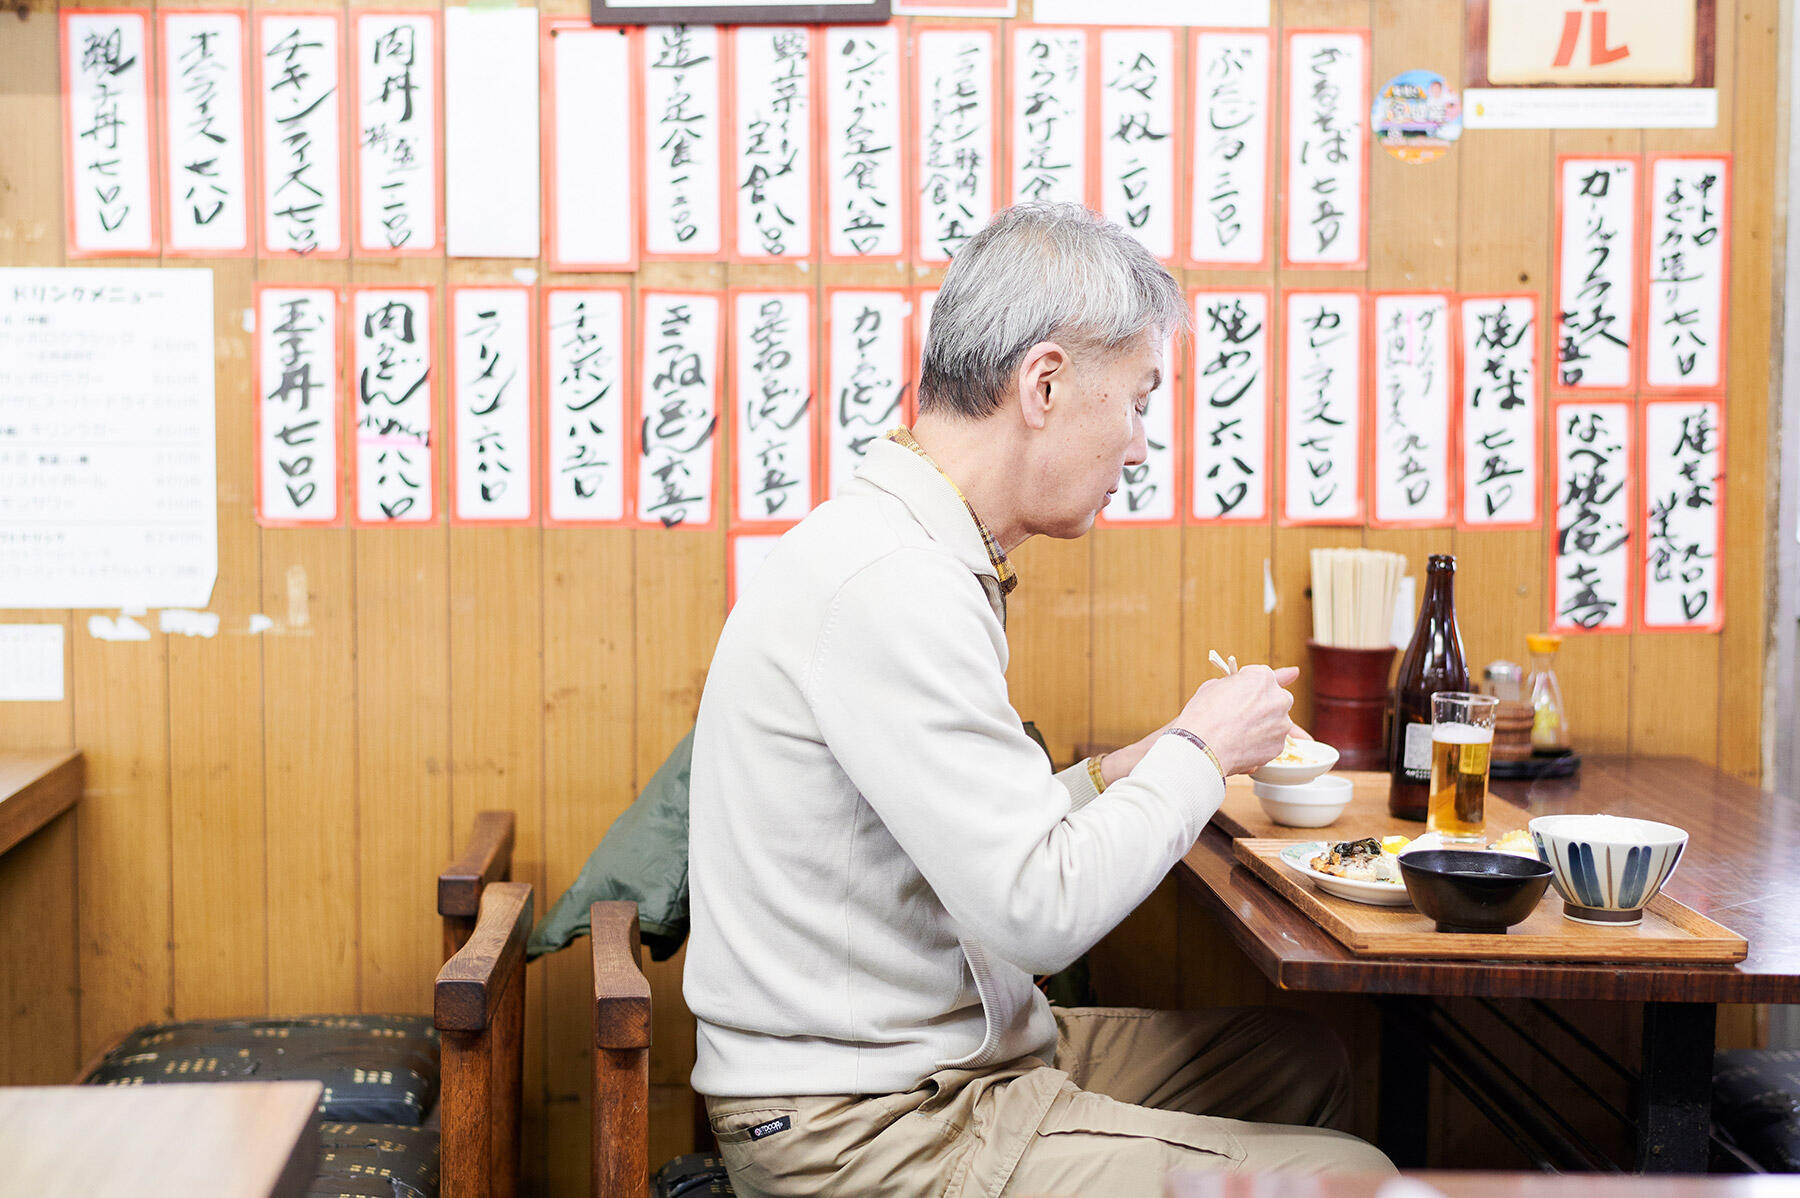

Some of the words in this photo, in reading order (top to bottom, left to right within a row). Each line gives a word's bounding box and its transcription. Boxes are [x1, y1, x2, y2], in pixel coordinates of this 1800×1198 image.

[1553, 0, 1630, 67] ル
[13, 286, 166, 303] ドリンクメニュー
